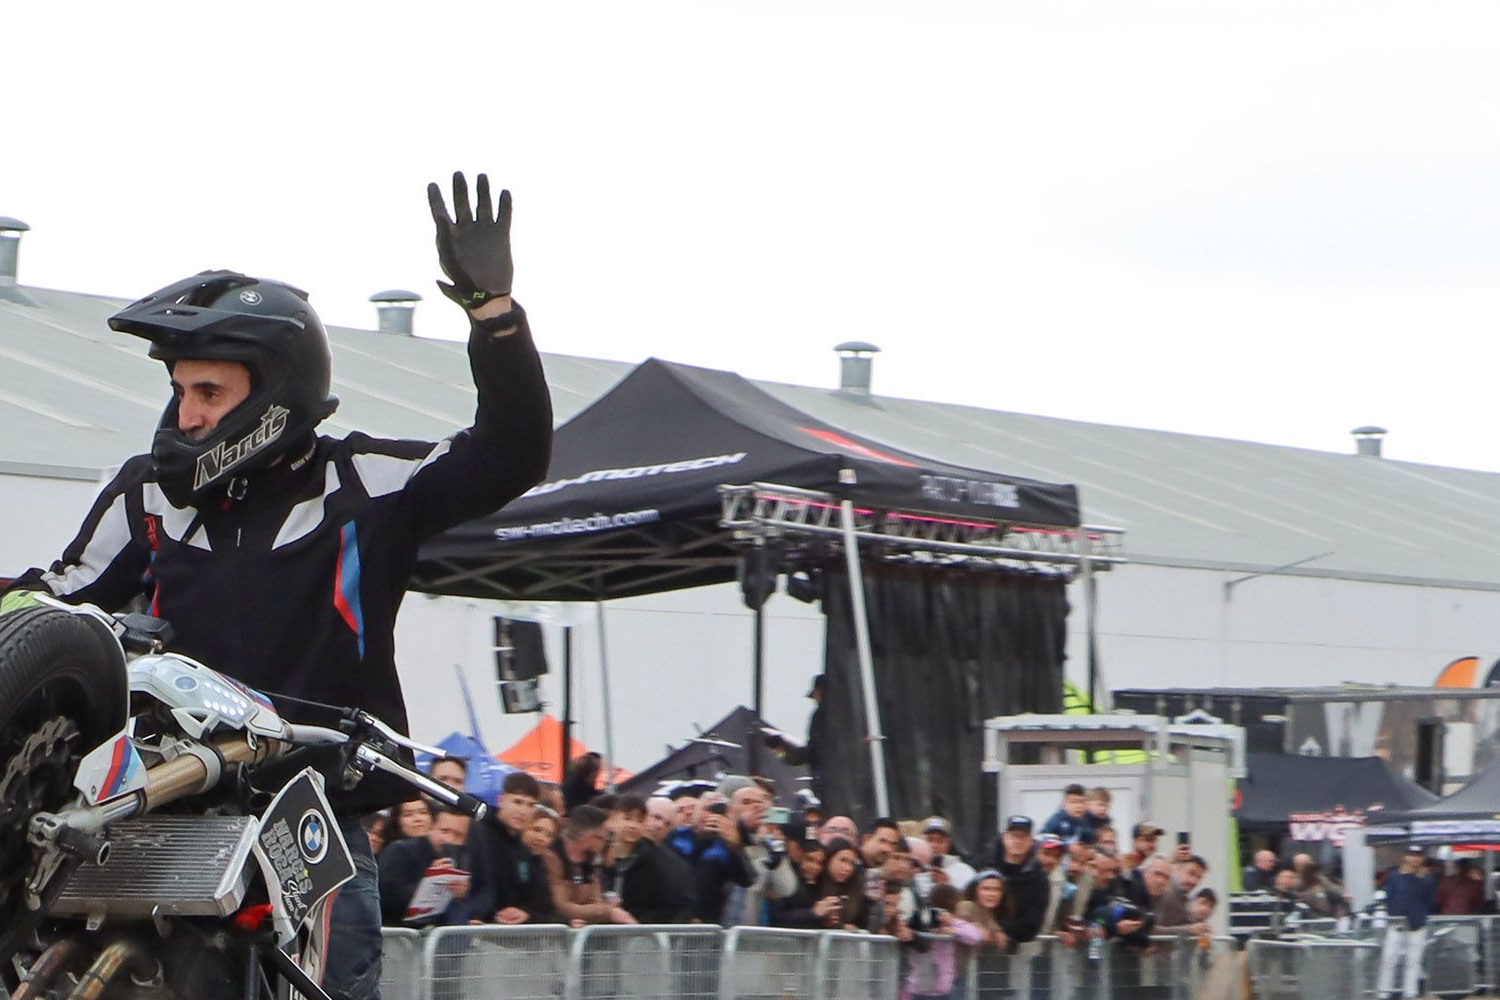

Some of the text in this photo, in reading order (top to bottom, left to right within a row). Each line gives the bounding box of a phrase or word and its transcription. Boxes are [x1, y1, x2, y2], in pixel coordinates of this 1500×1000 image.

[193, 404, 290, 491] Narcis
[518, 452, 748, 498] W-MOTECH
[494, 508, 660, 541] sw-motech.com
